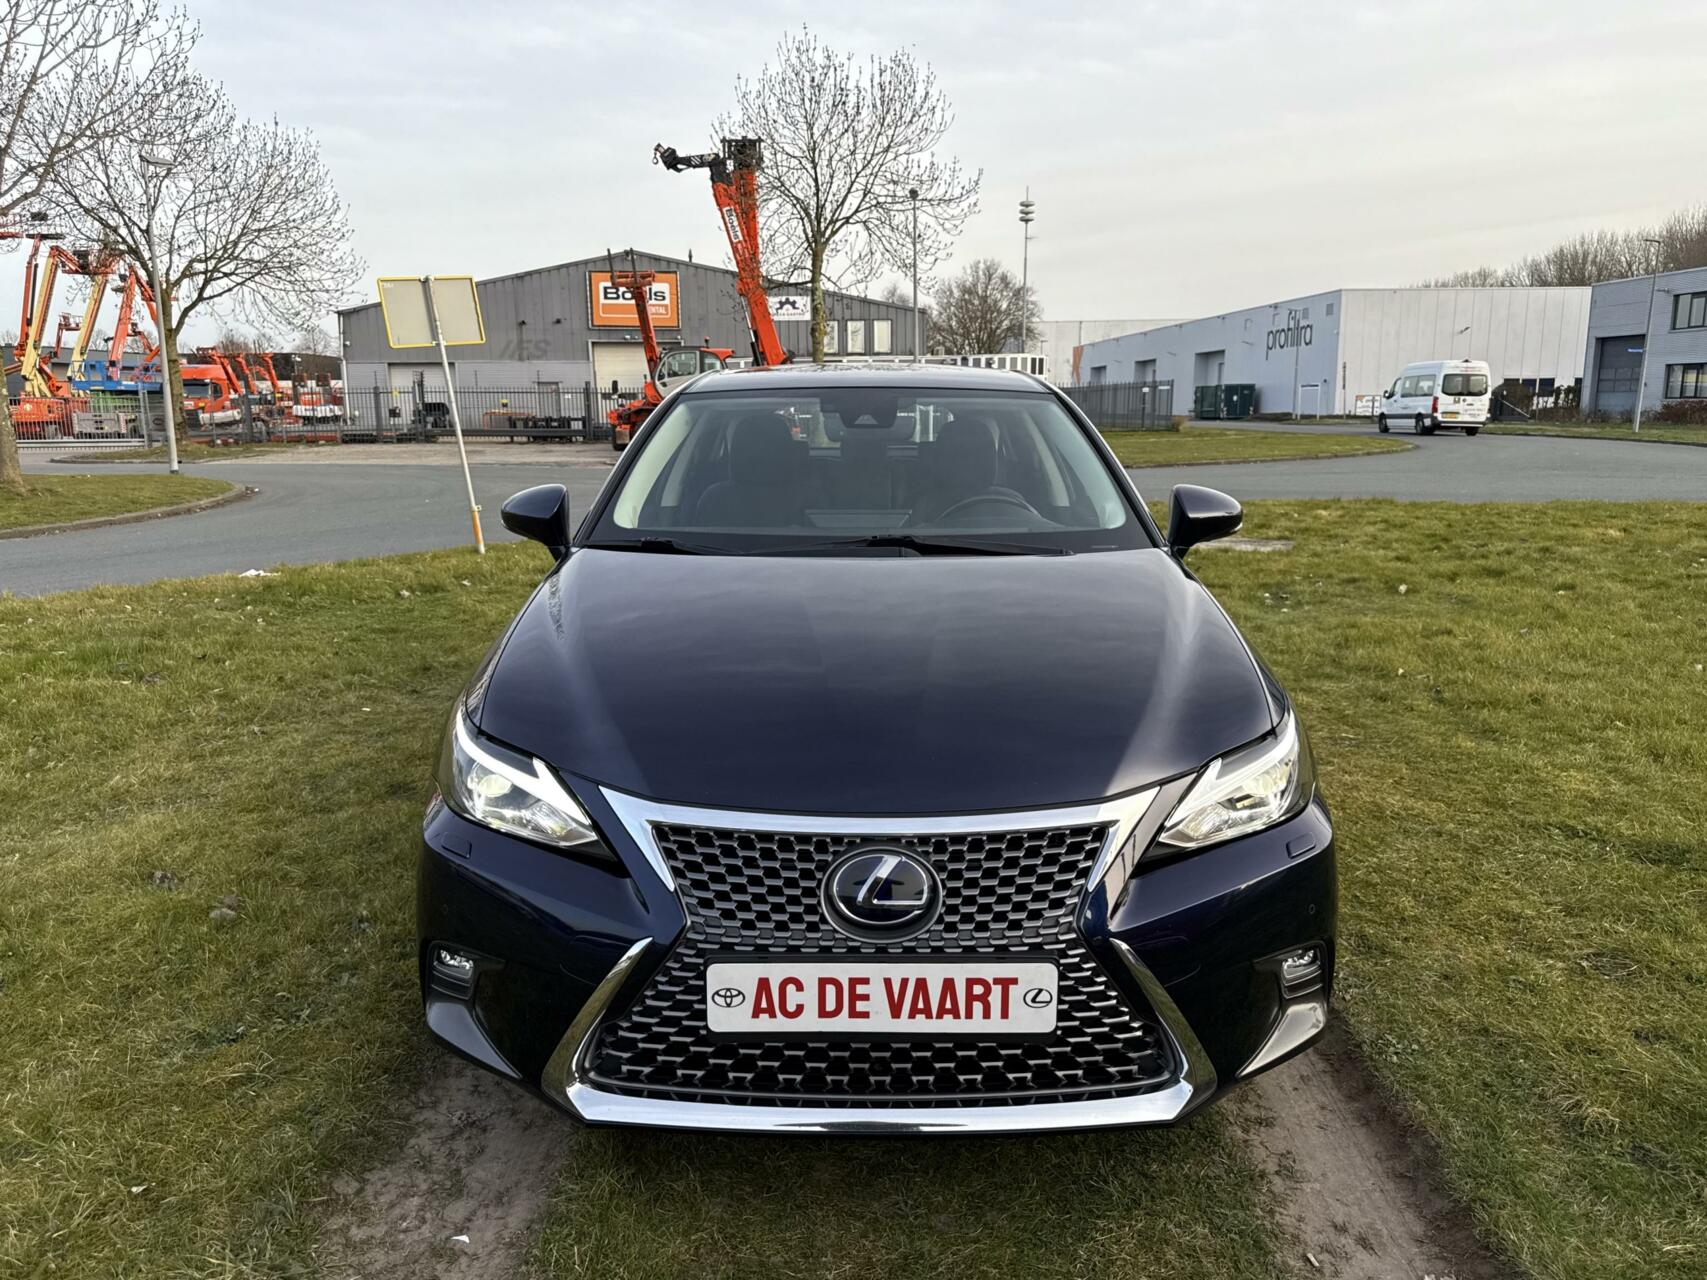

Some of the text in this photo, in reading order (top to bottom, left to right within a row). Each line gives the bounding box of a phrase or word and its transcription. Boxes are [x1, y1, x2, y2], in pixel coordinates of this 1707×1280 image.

[603, 286, 666, 301] Bols
[1266, 308, 1313, 361] profiltra
[751, 976, 805, 1019] AC
[817, 977, 871, 1019] DE
[883, 977, 1019, 1020] VAART
